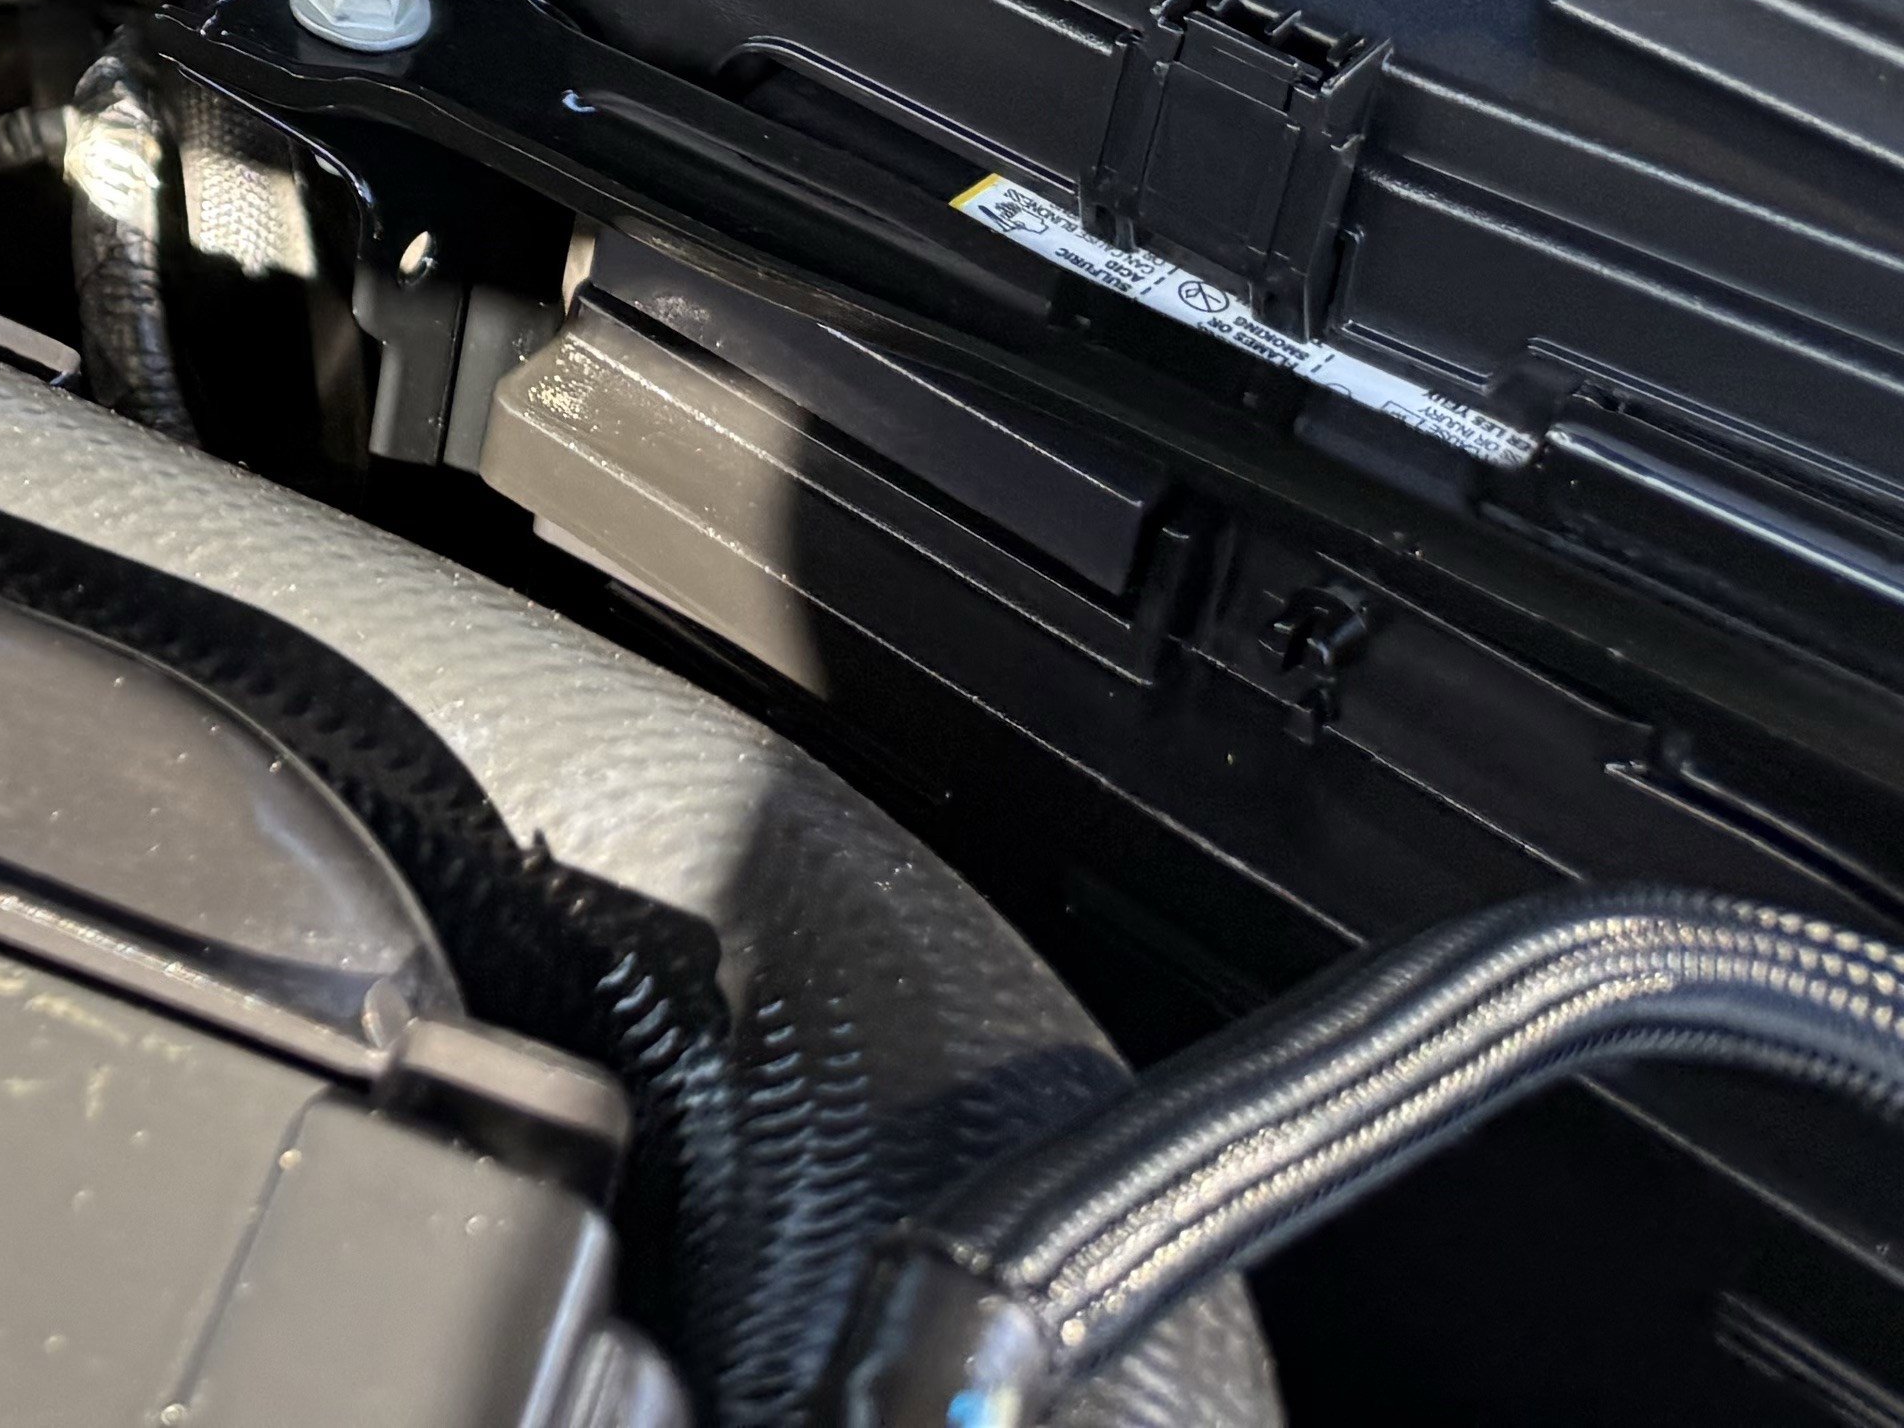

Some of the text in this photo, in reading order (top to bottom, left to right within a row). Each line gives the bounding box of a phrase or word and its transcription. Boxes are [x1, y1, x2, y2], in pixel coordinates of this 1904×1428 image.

[1002, 186, 1078, 234] BLINDNESS
[1053, 245, 1133, 292] SULFURIC
[1103, 258, 1144, 283] ACID
[1205, 316, 1234, 335] OR
[1232, 314, 1311, 361] SMOKING
[1416, 404, 1475, 439] INJURY
